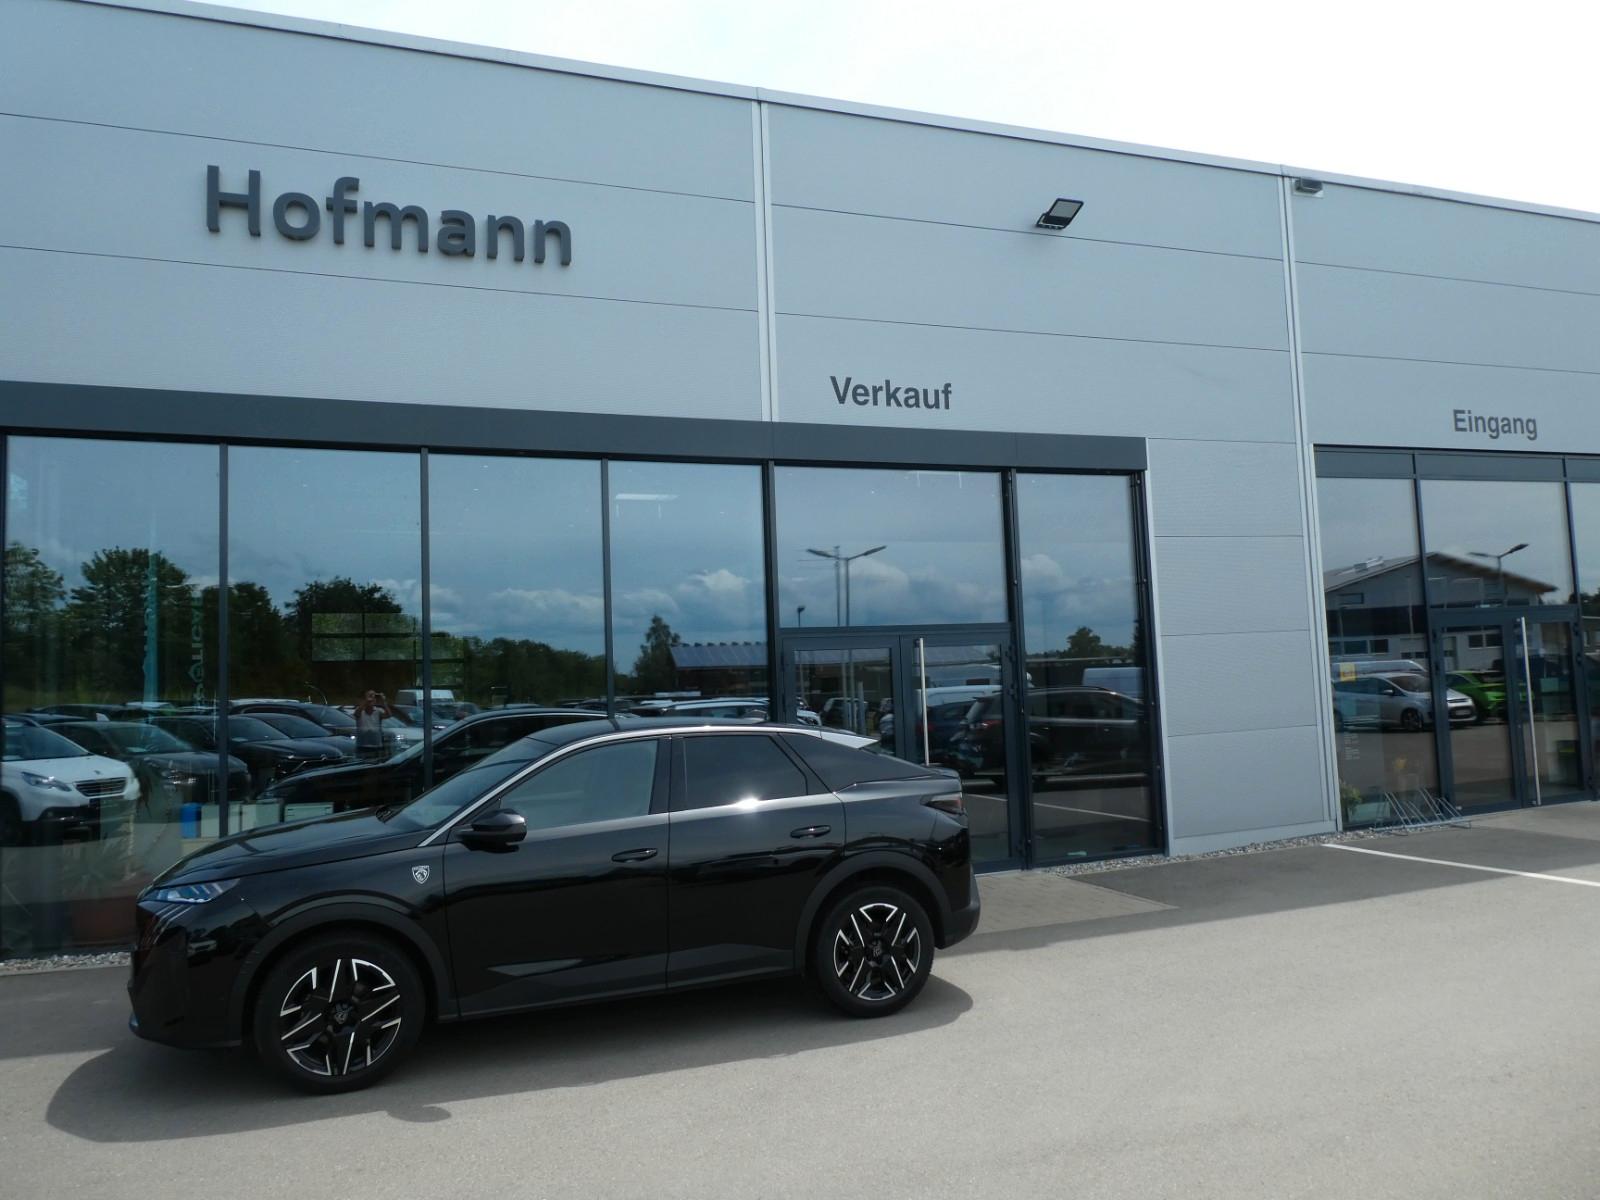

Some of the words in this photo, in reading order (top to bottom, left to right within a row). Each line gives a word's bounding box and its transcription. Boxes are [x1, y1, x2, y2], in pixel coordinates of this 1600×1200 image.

[207, 165, 572, 266] Hofmann
[830, 375, 952, 410] Verkauf
[1453, 409, 1538, 441] Eingang
